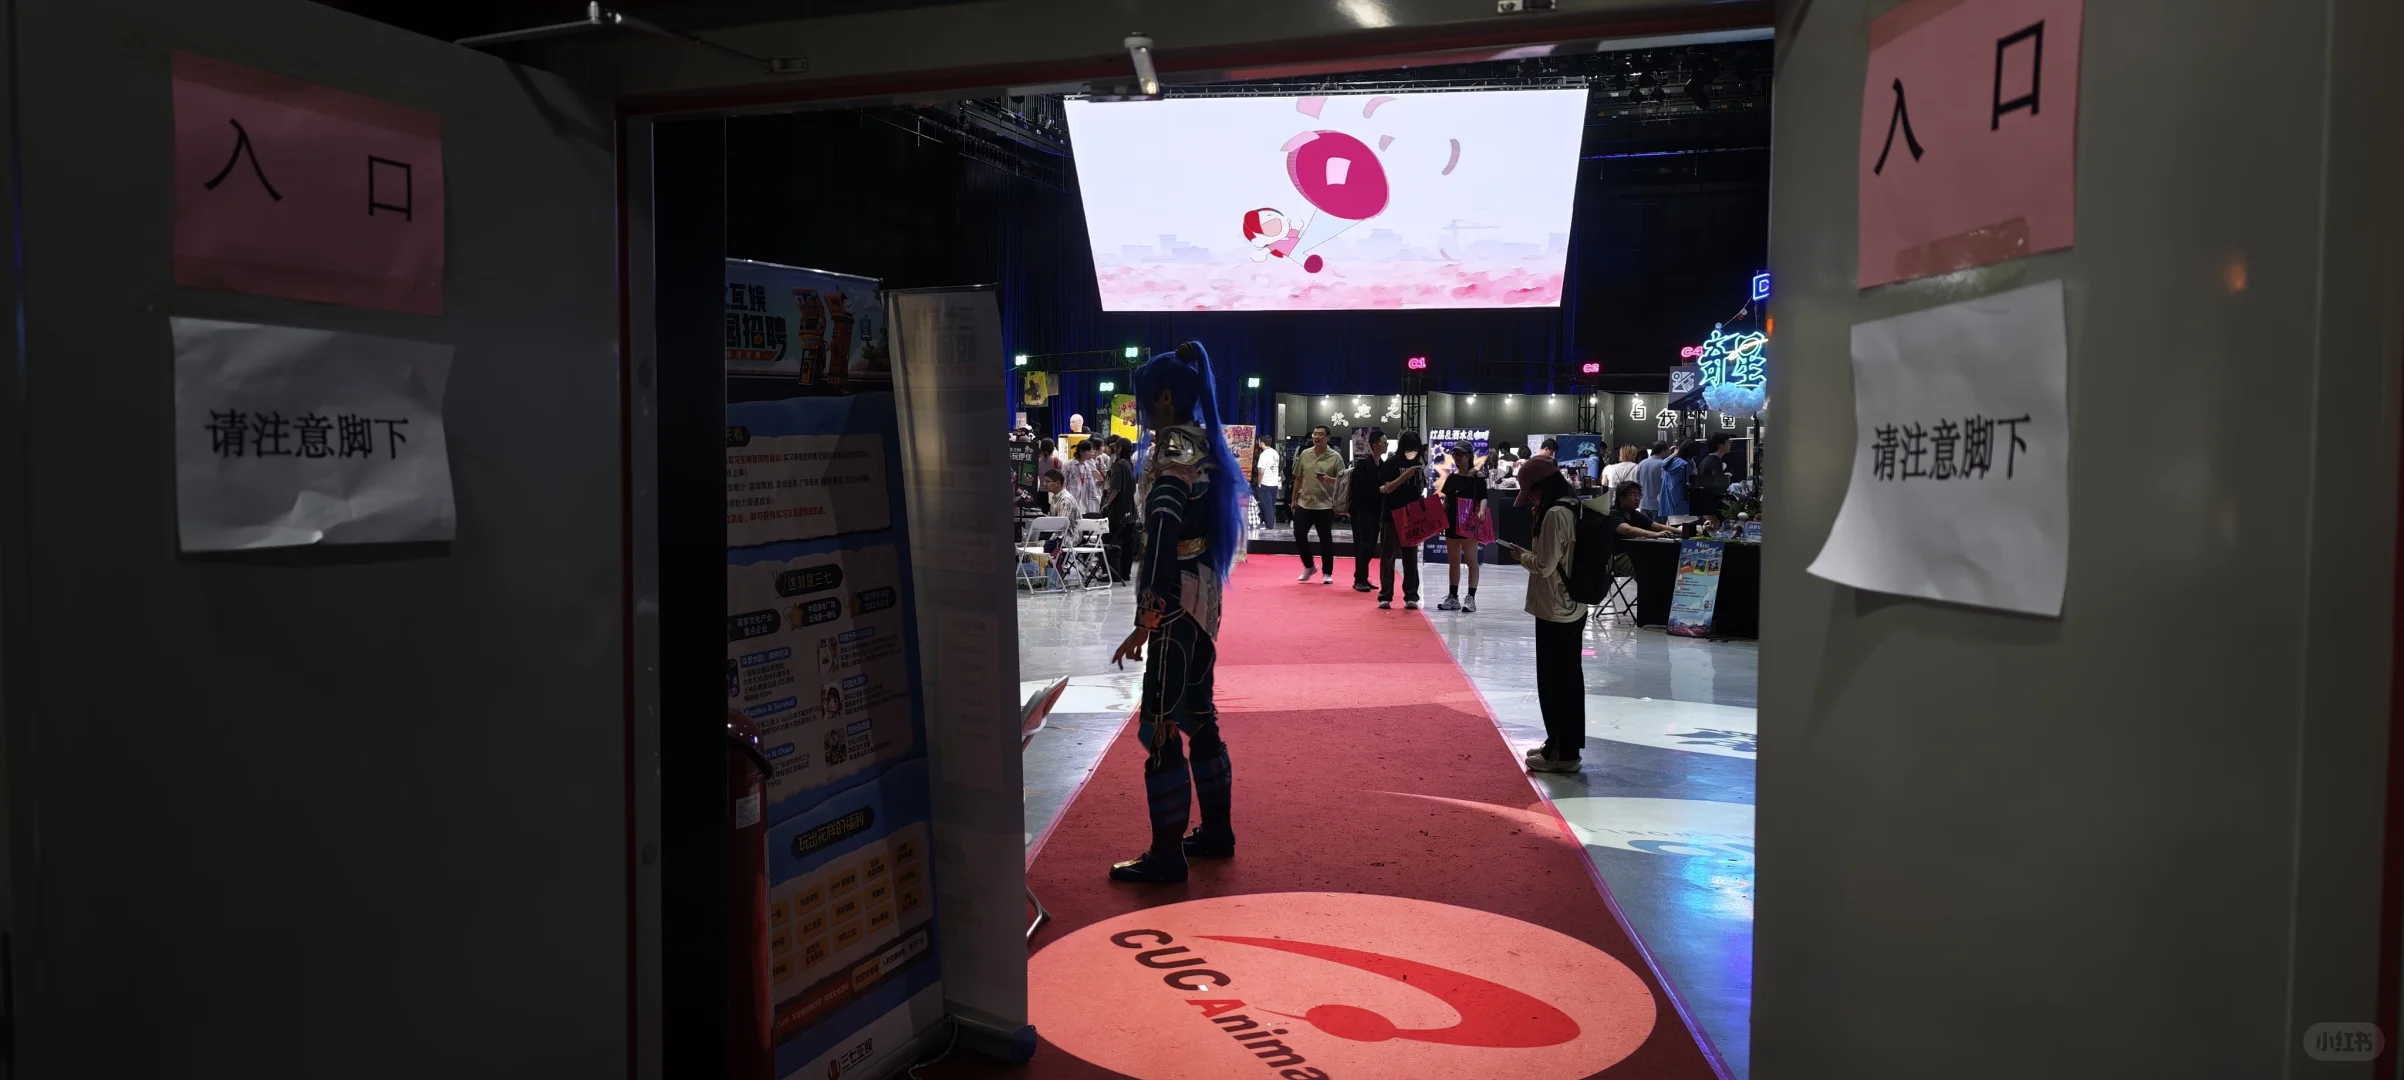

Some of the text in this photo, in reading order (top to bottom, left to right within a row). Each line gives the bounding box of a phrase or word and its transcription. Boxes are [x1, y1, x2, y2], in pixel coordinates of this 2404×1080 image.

[1873, 20, 2044, 176] 入口
[205, 118, 412, 222] 入口
[726, 283, 767, 312] 互娱
[1408, 357, 1427, 370] C1
[1681, 346, 1703, 358] C4
[205, 409, 409, 462] 请注意脚下
[1871, 413, 2031, 483] 请注意脚下
[788, 571, 833, 591] 这就是三七
[799, 810, 865, 851] 玩出花样的福利
[1110, 927, 1232, 992] CUC
[841, 1038, 873, 1070] 三七互娱
